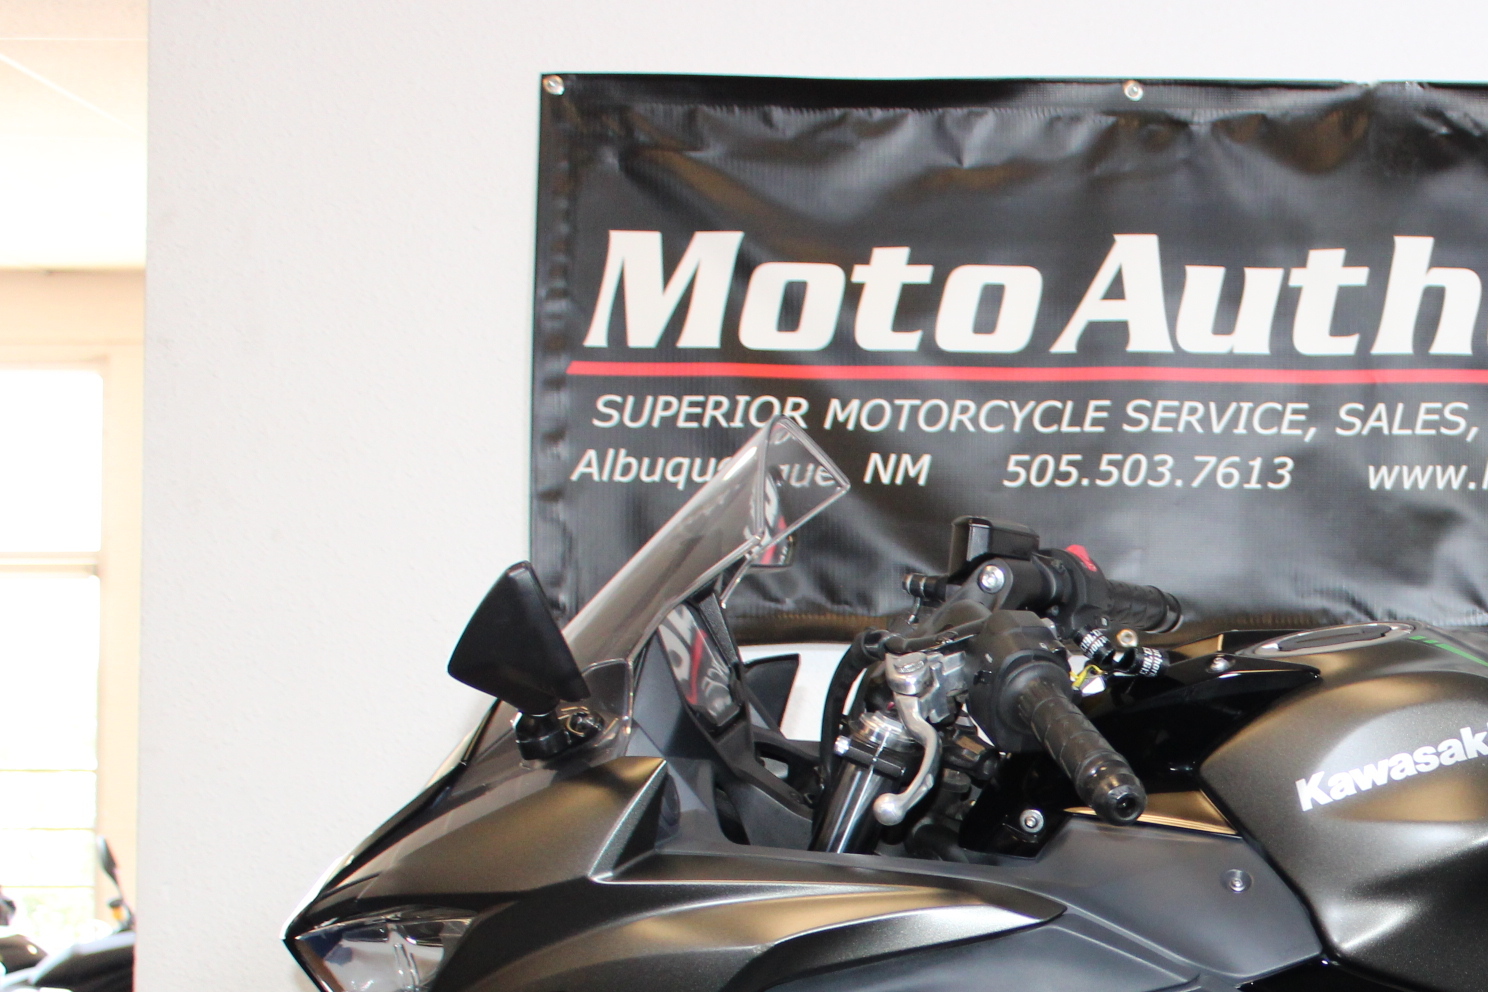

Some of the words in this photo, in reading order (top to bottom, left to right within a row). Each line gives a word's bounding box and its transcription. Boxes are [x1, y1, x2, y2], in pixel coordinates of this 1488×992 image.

[584, 231, 1042, 353] Moto
[592, 394, 808, 429] SUPERIOR
[824, 399, 1111, 433] MOTORCYCLE
[1123, 401, 1318, 442] SERVICE,
[1336, 402, 1479, 442] SALES,
[864, 453, 931, 485] NM
[1003, 453, 1294, 489] 505.503.7613
